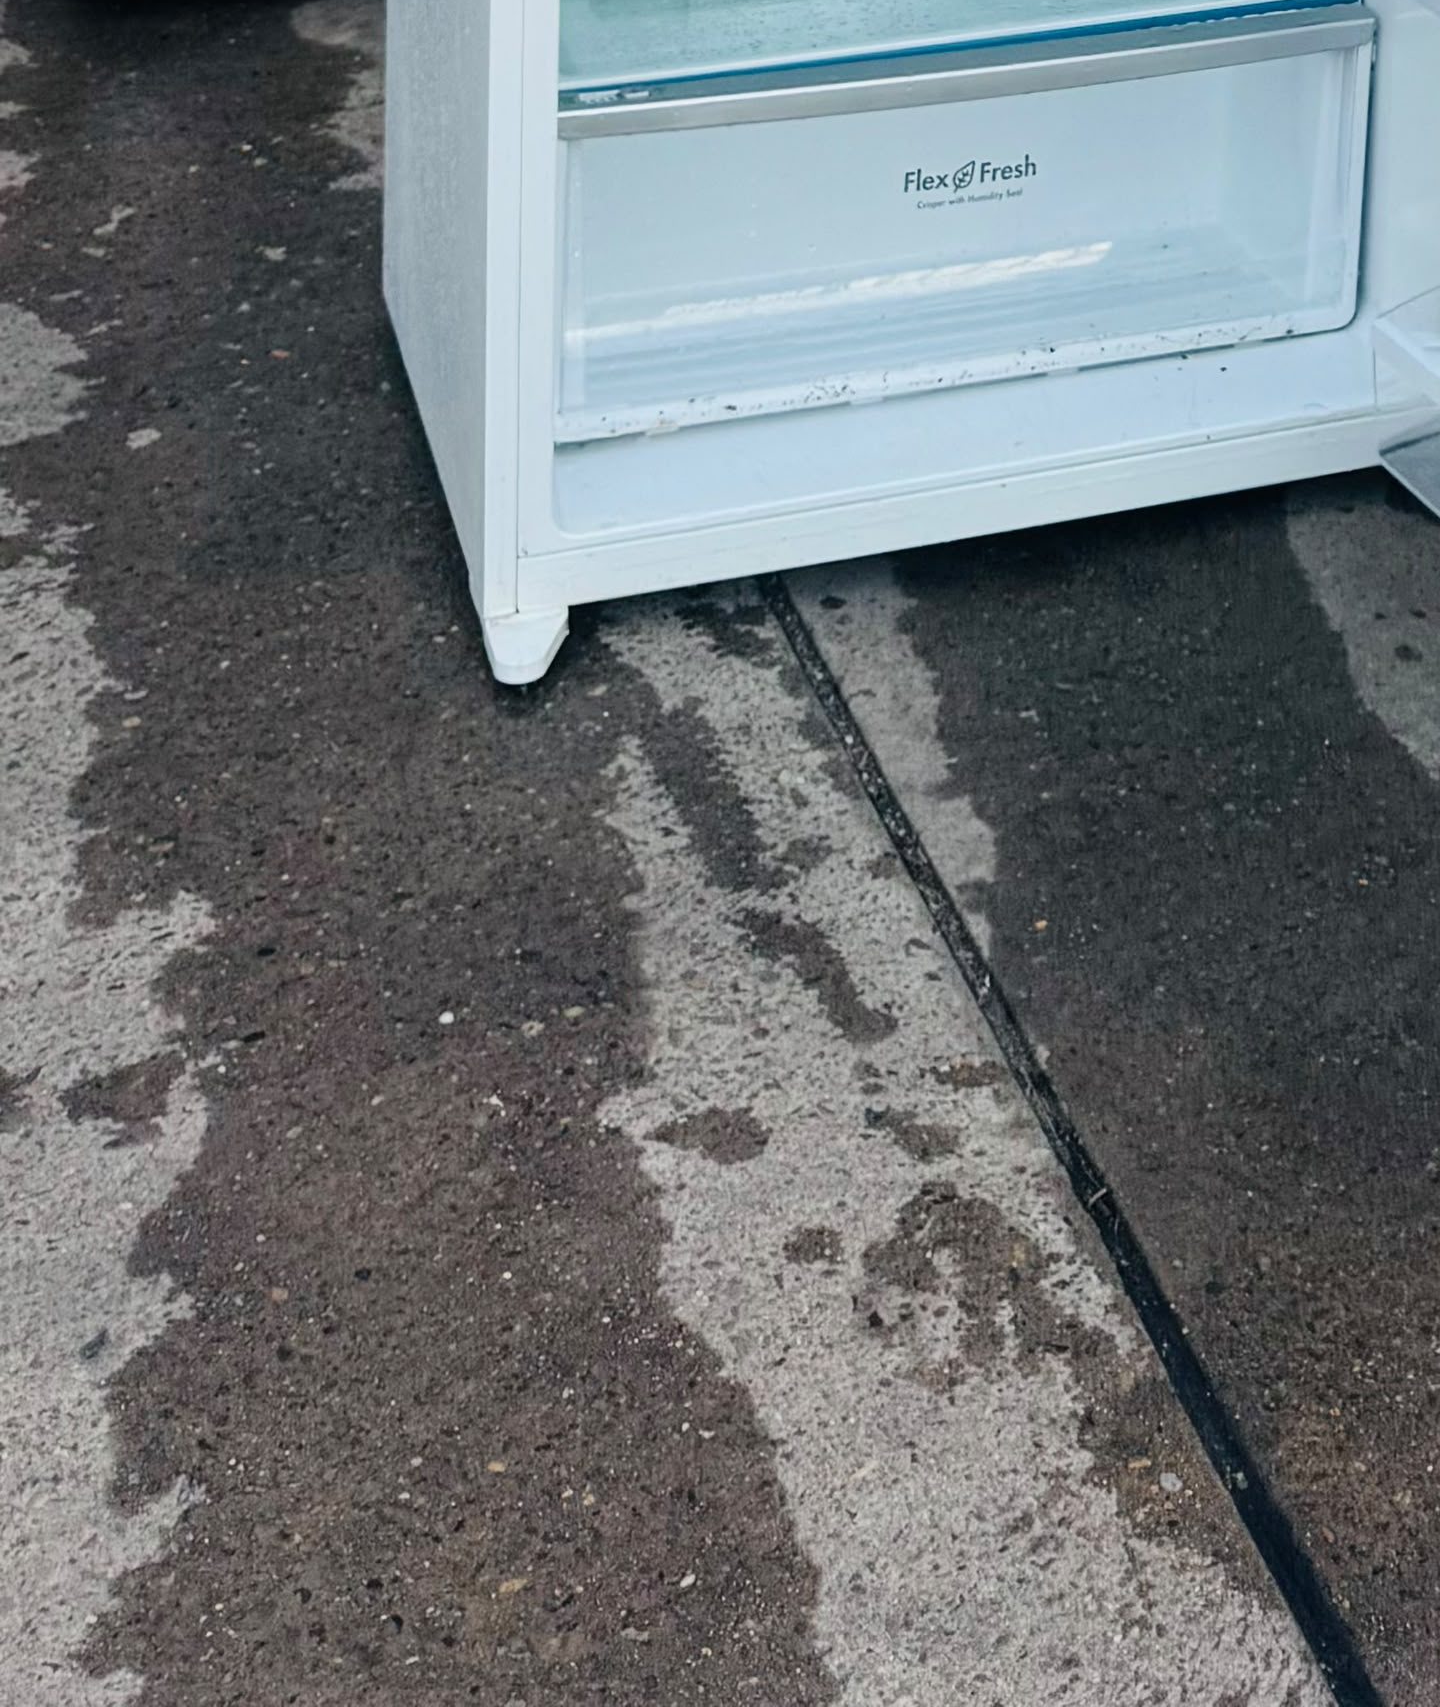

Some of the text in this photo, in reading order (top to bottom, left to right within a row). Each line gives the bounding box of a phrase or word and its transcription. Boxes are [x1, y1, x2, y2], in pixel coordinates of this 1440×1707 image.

[904, 153, 1037, 193] Flex Fresh
[949, 196, 965, 205] with
